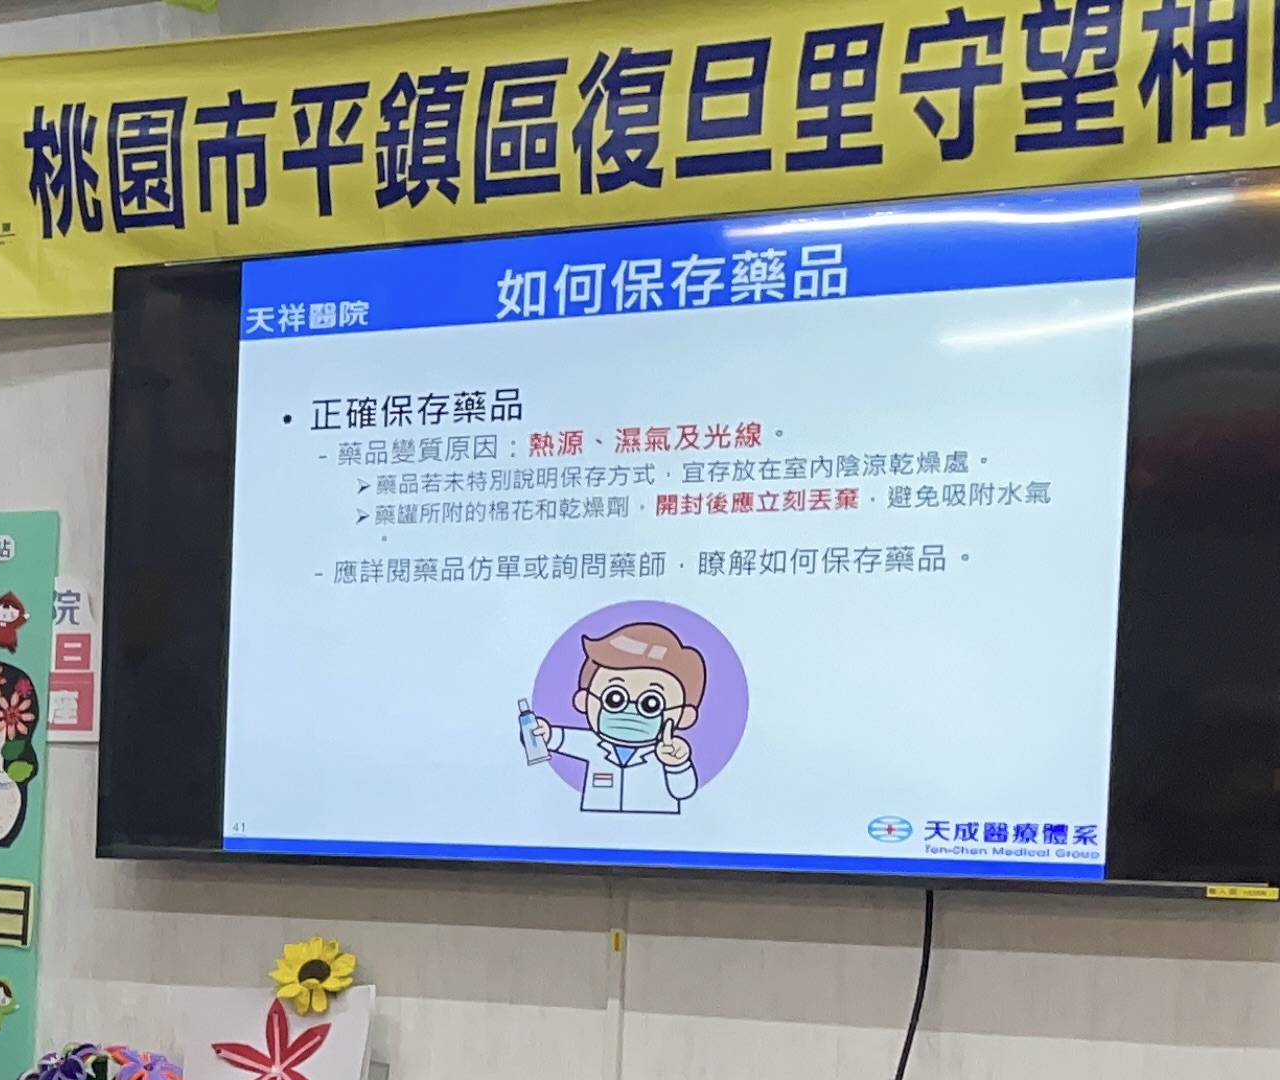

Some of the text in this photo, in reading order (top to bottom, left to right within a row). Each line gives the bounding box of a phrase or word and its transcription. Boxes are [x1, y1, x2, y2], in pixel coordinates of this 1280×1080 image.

[24, 0, 1280, 239] 桃園市平鎮區復旦里守望相
[496, 244, 848, 319] 如何保存藥品
[244, 299, 370, 335] 天祥醫院
[310, 387, 523, 431] 正確保存藥品
[924, 820, 1098, 846] 天成醫療體系
[992, 846, 1050, 858] Medical
[1055, 848, 1100, 860] Group
